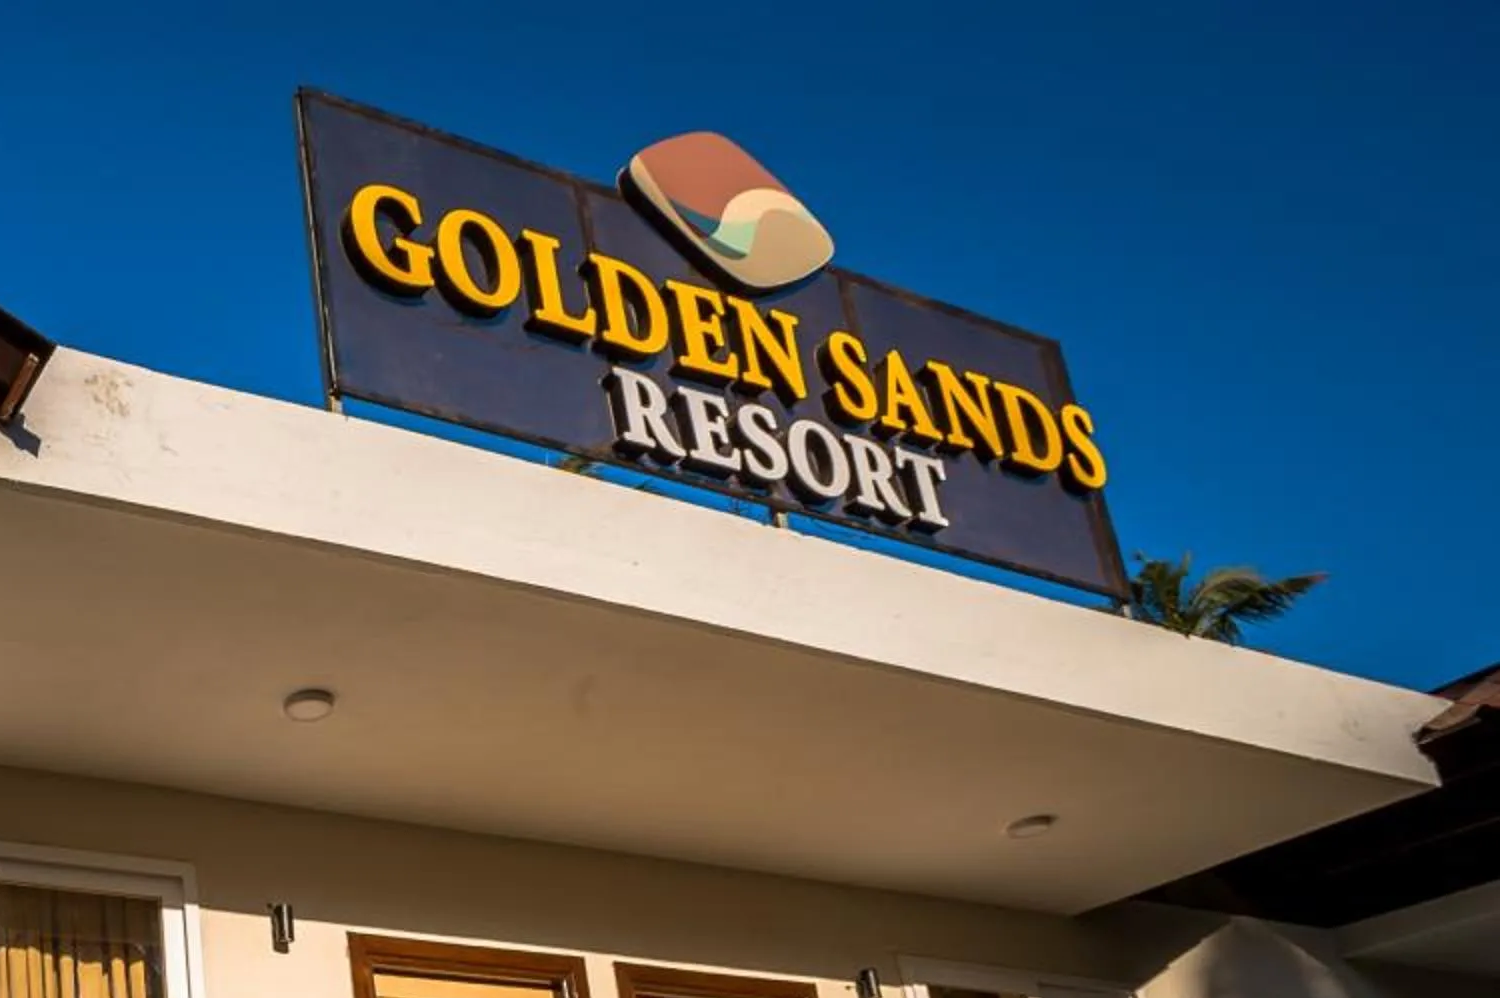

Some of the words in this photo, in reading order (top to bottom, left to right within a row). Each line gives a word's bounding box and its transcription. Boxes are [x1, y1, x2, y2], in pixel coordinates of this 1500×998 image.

[348, 183, 809, 400] GOLDEN
[827, 330, 1108, 490] SANDS
[607, 366, 949, 532] RESORT
